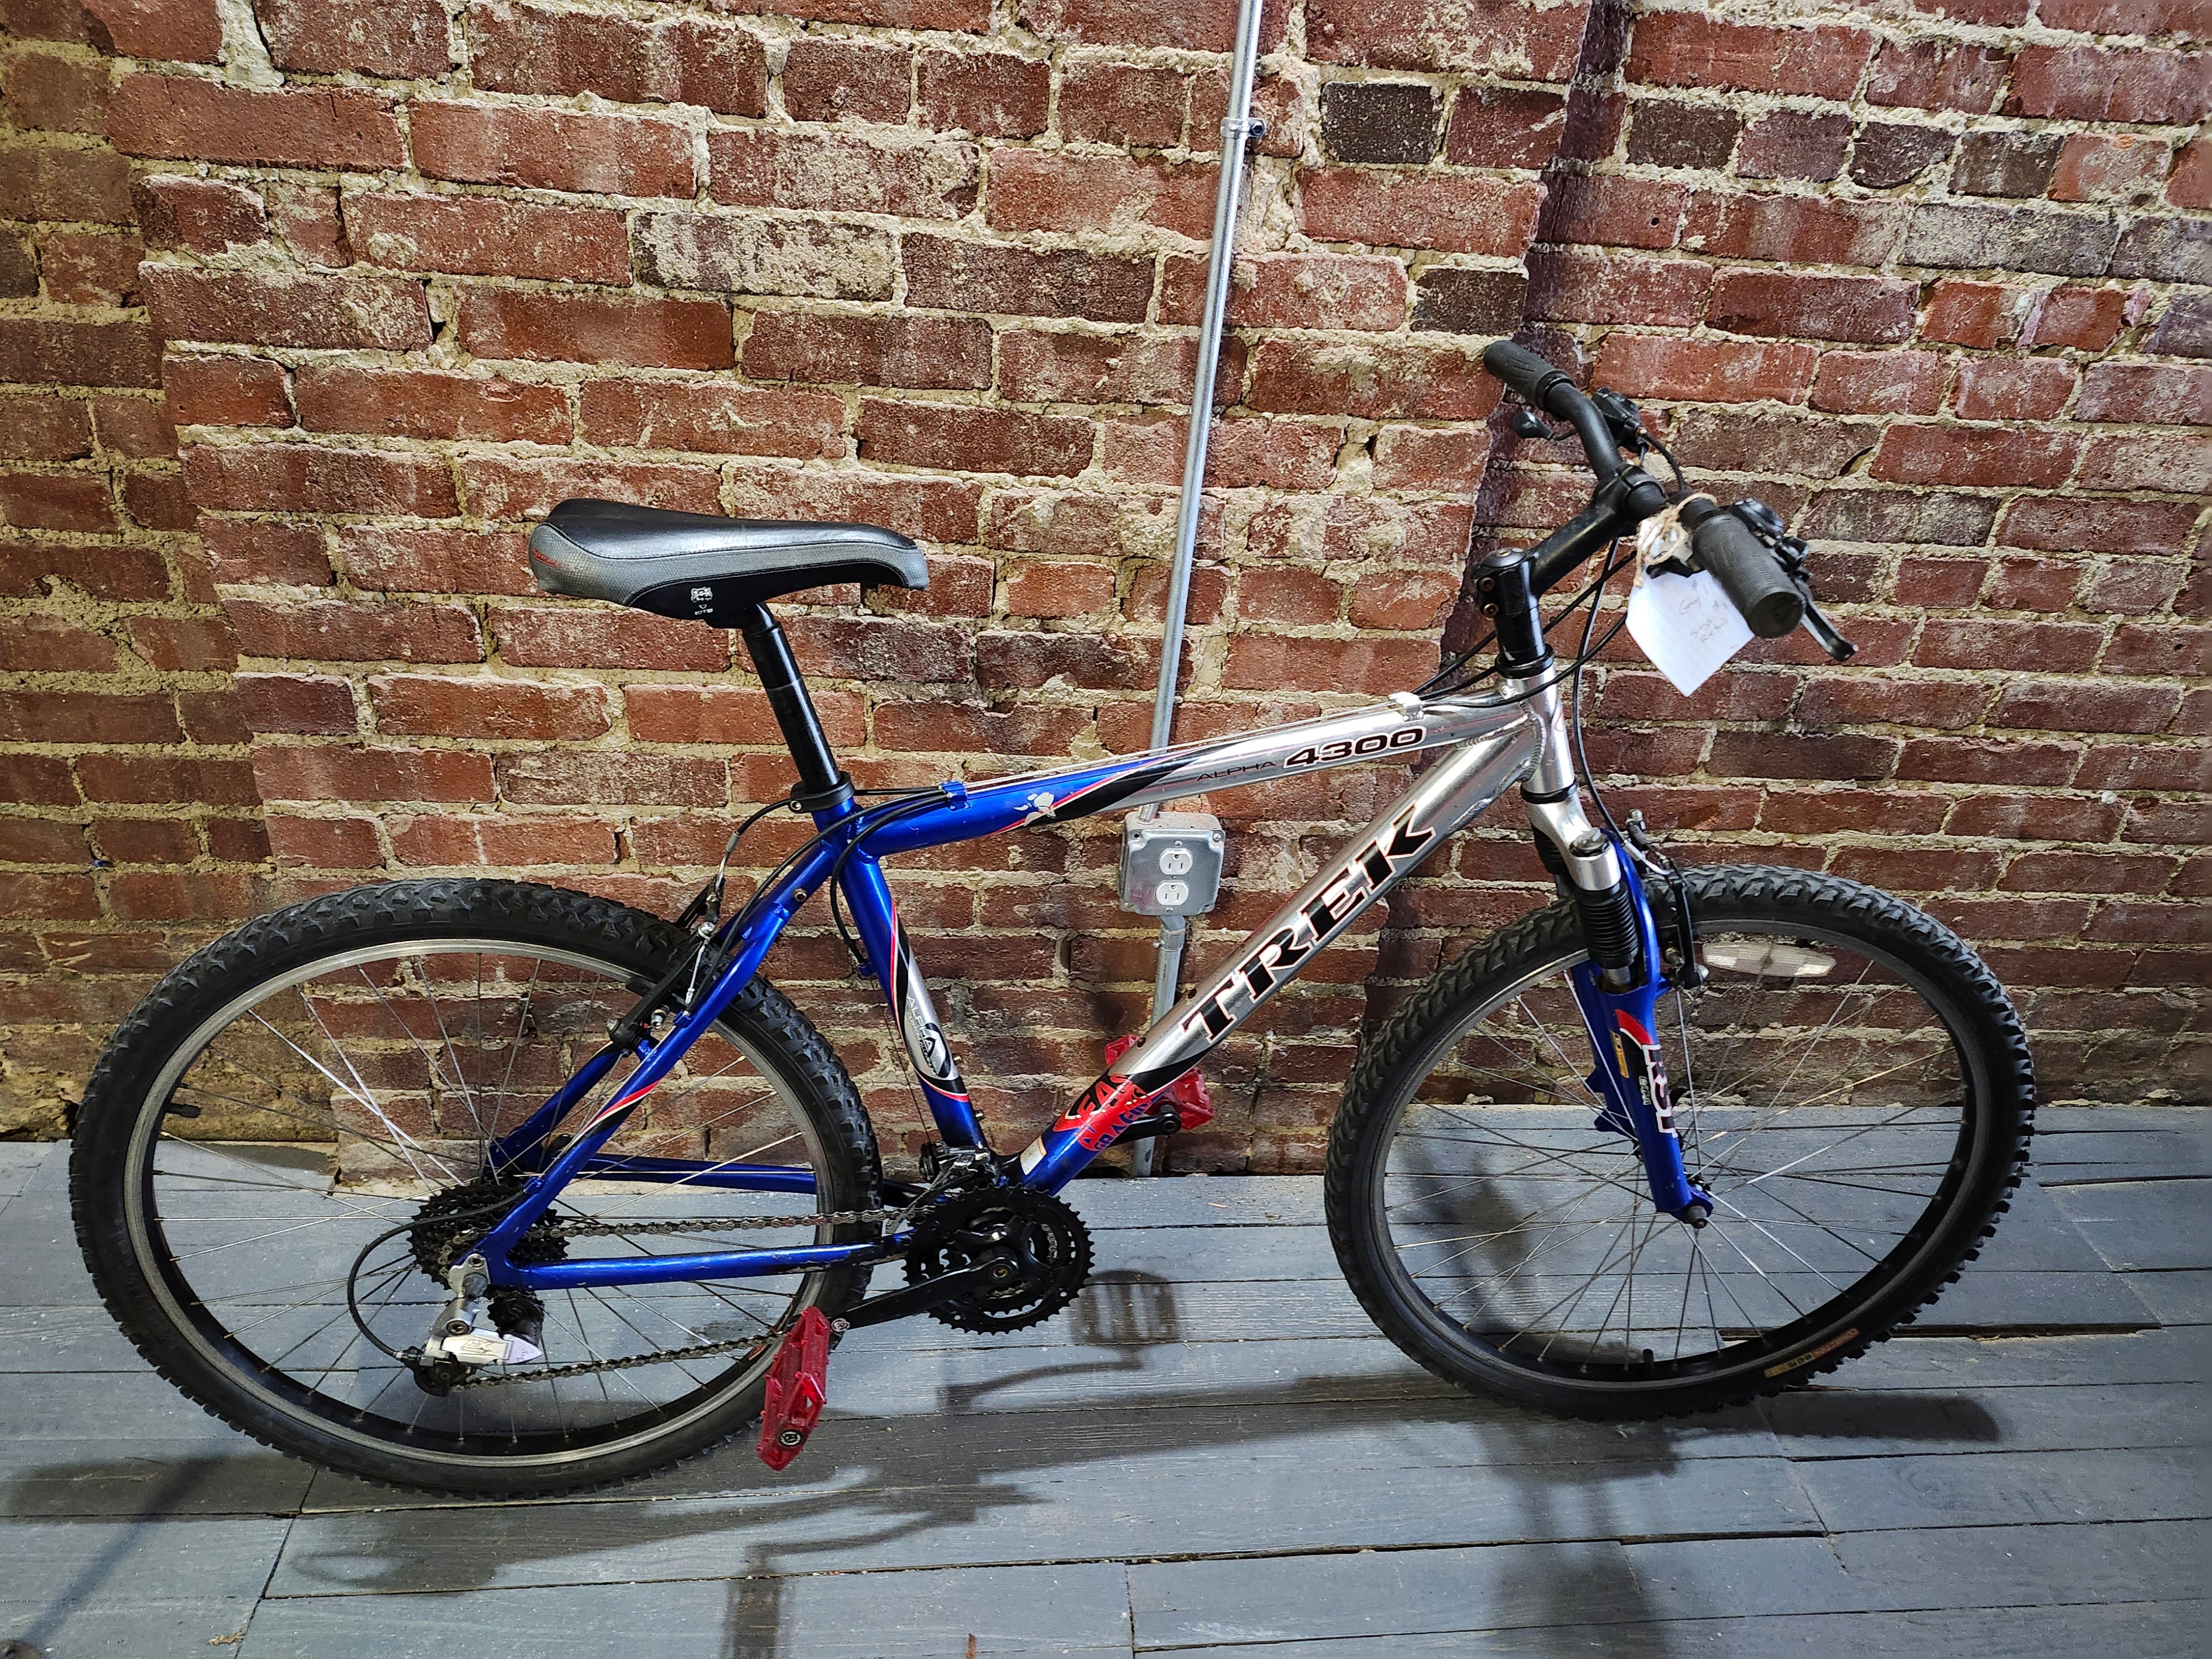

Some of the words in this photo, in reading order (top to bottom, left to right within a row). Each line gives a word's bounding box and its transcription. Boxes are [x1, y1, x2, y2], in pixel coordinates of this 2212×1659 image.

[1197, 760, 1277, 781] ALPHA
[1283, 726, 1427, 769] 4300
[1178, 800, 1437, 1044] TREK
[906, 995, 933, 1053] ALPHA
